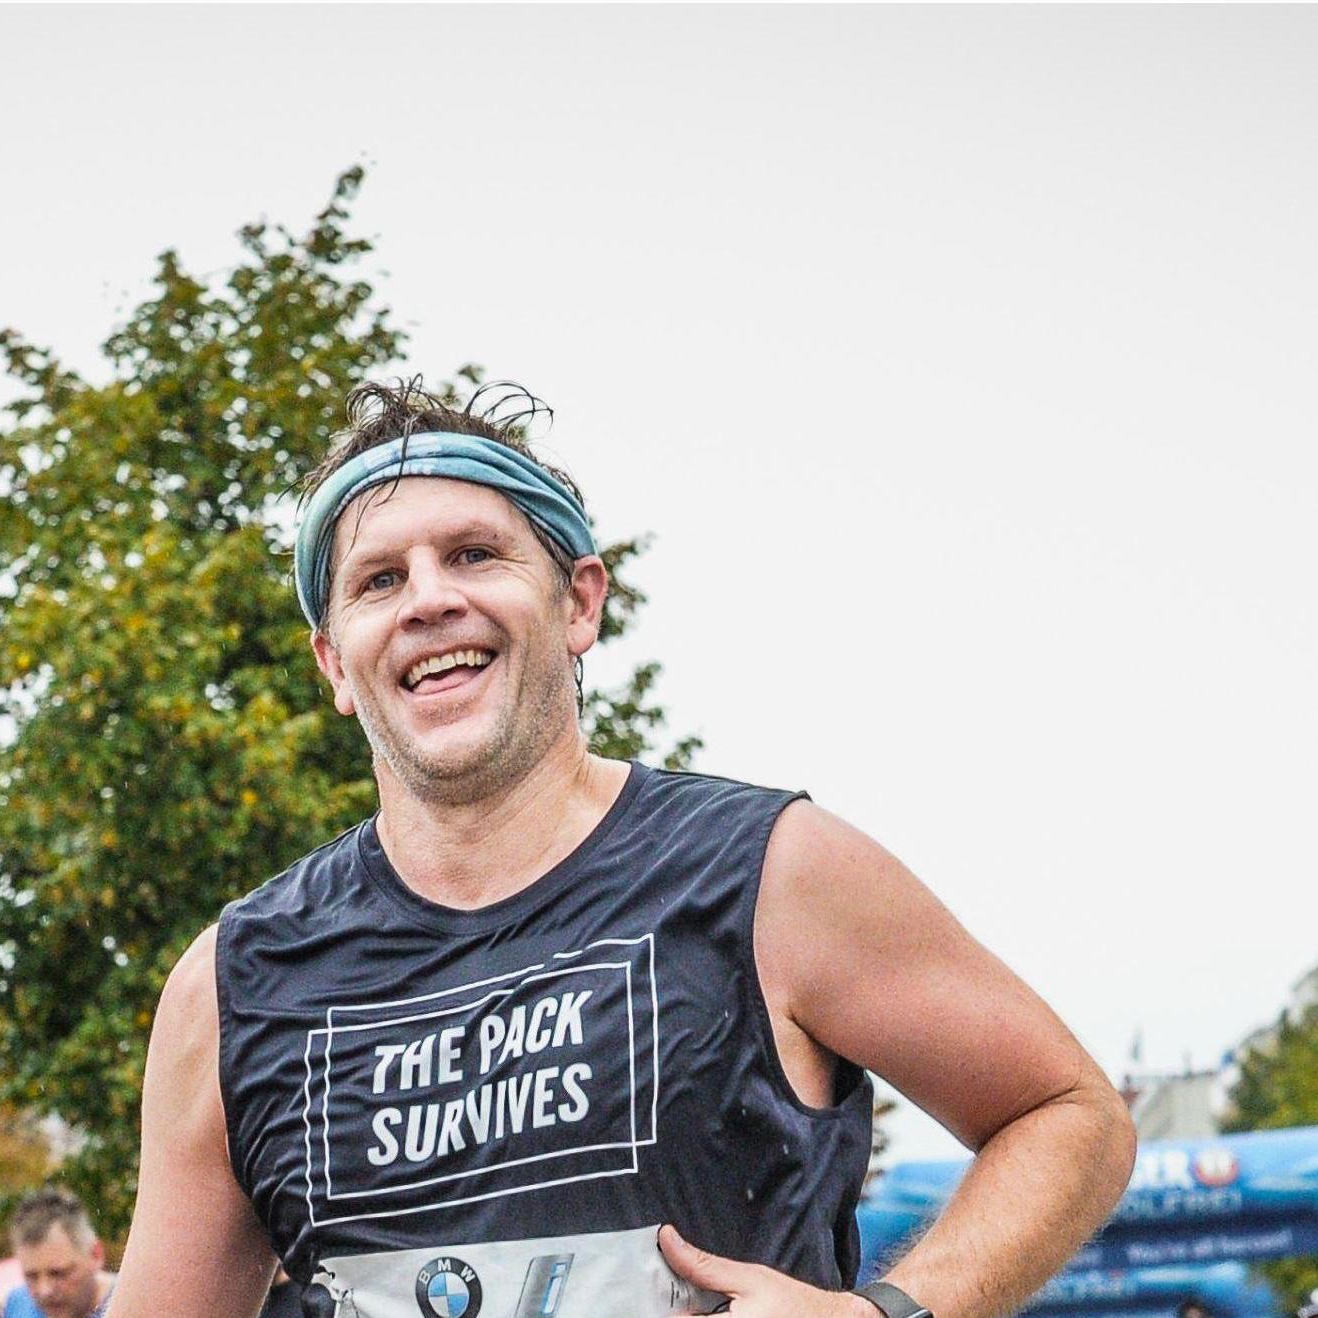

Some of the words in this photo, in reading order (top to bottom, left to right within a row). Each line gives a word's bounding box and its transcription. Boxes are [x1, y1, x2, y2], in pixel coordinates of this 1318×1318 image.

[371, 1025, 466, 1095] THE
[479, 990, 594, 1075] PACK
[366, 1062, 594, 1166] SURVIVES
[418, 1258, 476, 1285] BMW
